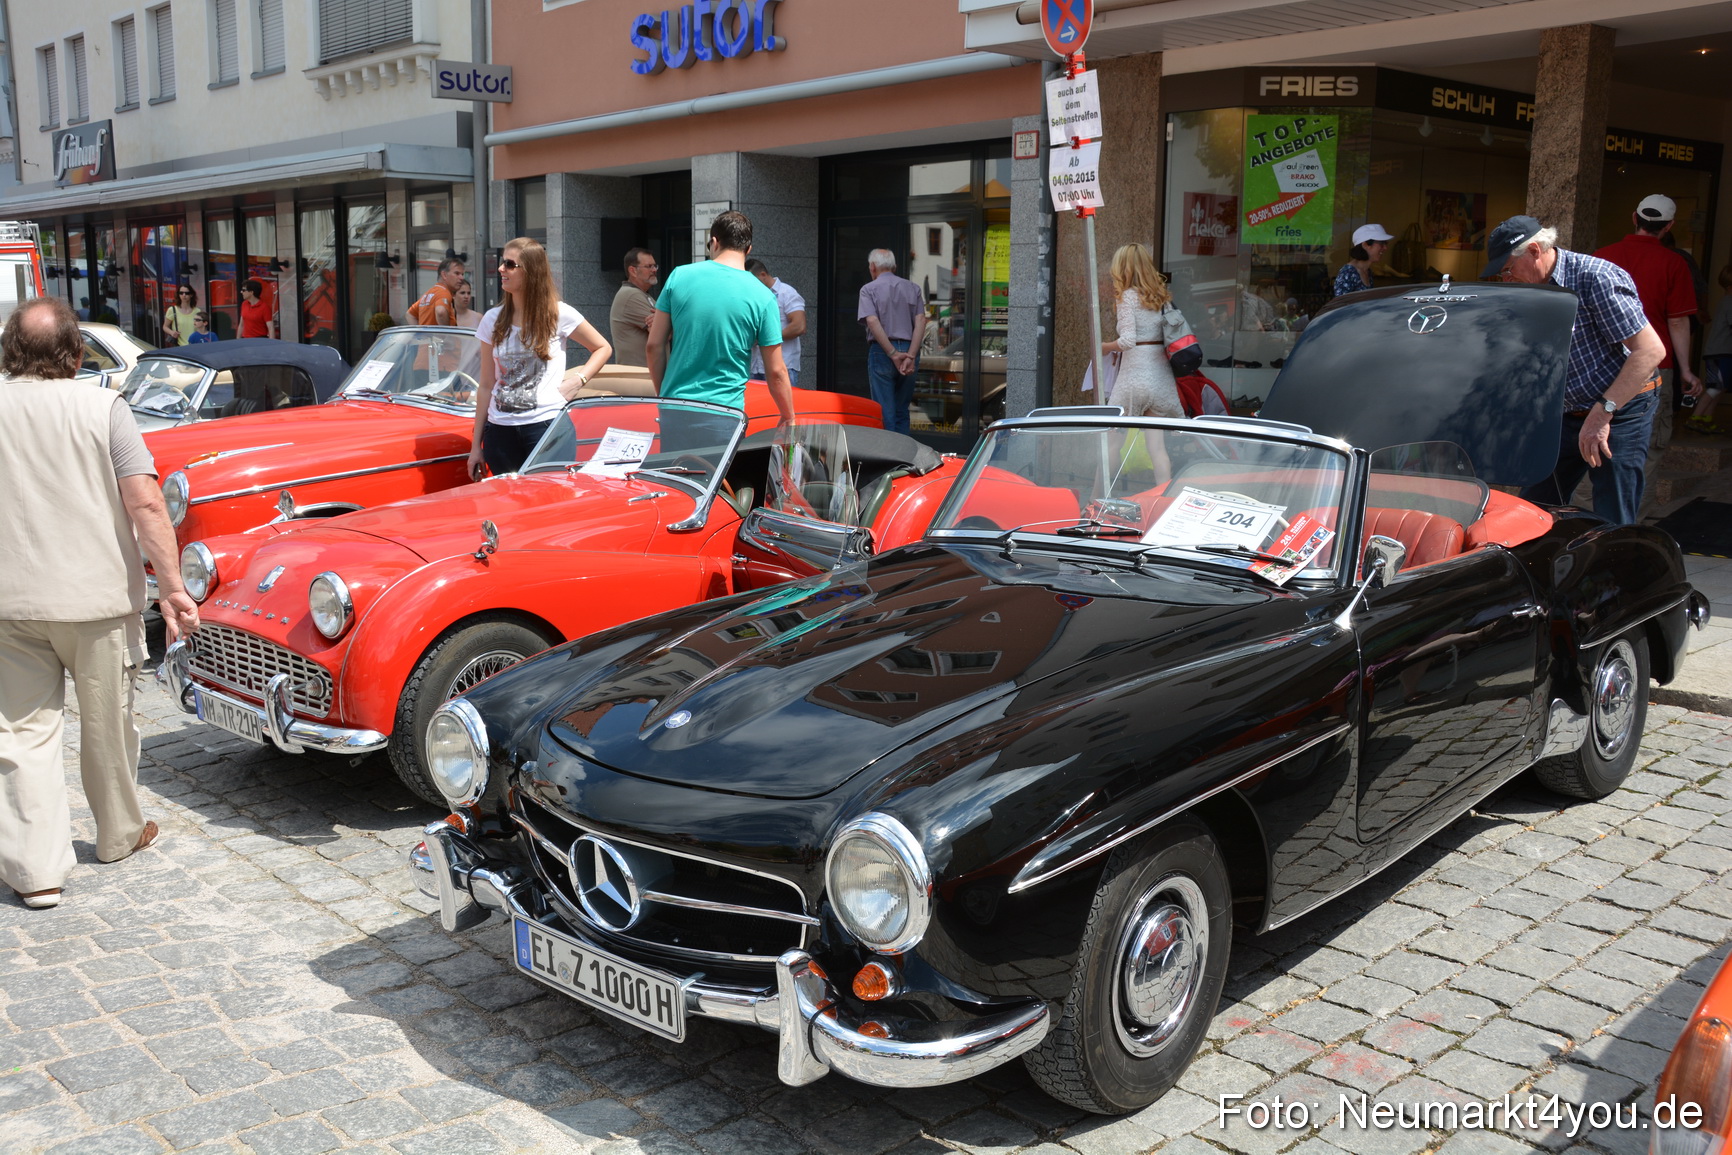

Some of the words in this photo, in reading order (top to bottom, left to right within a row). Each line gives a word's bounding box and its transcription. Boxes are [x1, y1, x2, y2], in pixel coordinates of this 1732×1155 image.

[1057, 87, 1074, 98] auch
[1075, 83, 1087, 94] auf
[1260, 76, 1359, 97] FRIES
[1065, 101, 1081, 110] dem
[1431, 87, 1496, 116] SCHUH
[1516, 101, 1536, 122] FR
[1051, 110, 1099, 127] Seitenstreifen
[1250, 126, 1336, 169] ANGEBOTE
[1605, 134, 1644, 155] CHUH
[1658, 142, 1695, 162] FRIES
[1069, 156, 1080, 168] Ab
[1052, 171, 1096, 187] 04.06.2015
[1057, 190, 1080, 203] 07:00
[1080, 189, 1095, 200] Uhr
[1249, 207, 1273, 225] 20-50%
[1271, 194, 1307, 216] REDUZIERT
[621, 443, 645, 459] 455
[1216, 510, 1256, 529] 204
[201, 694, 217, 722] NM
[531, 931, 557, 977] EI
